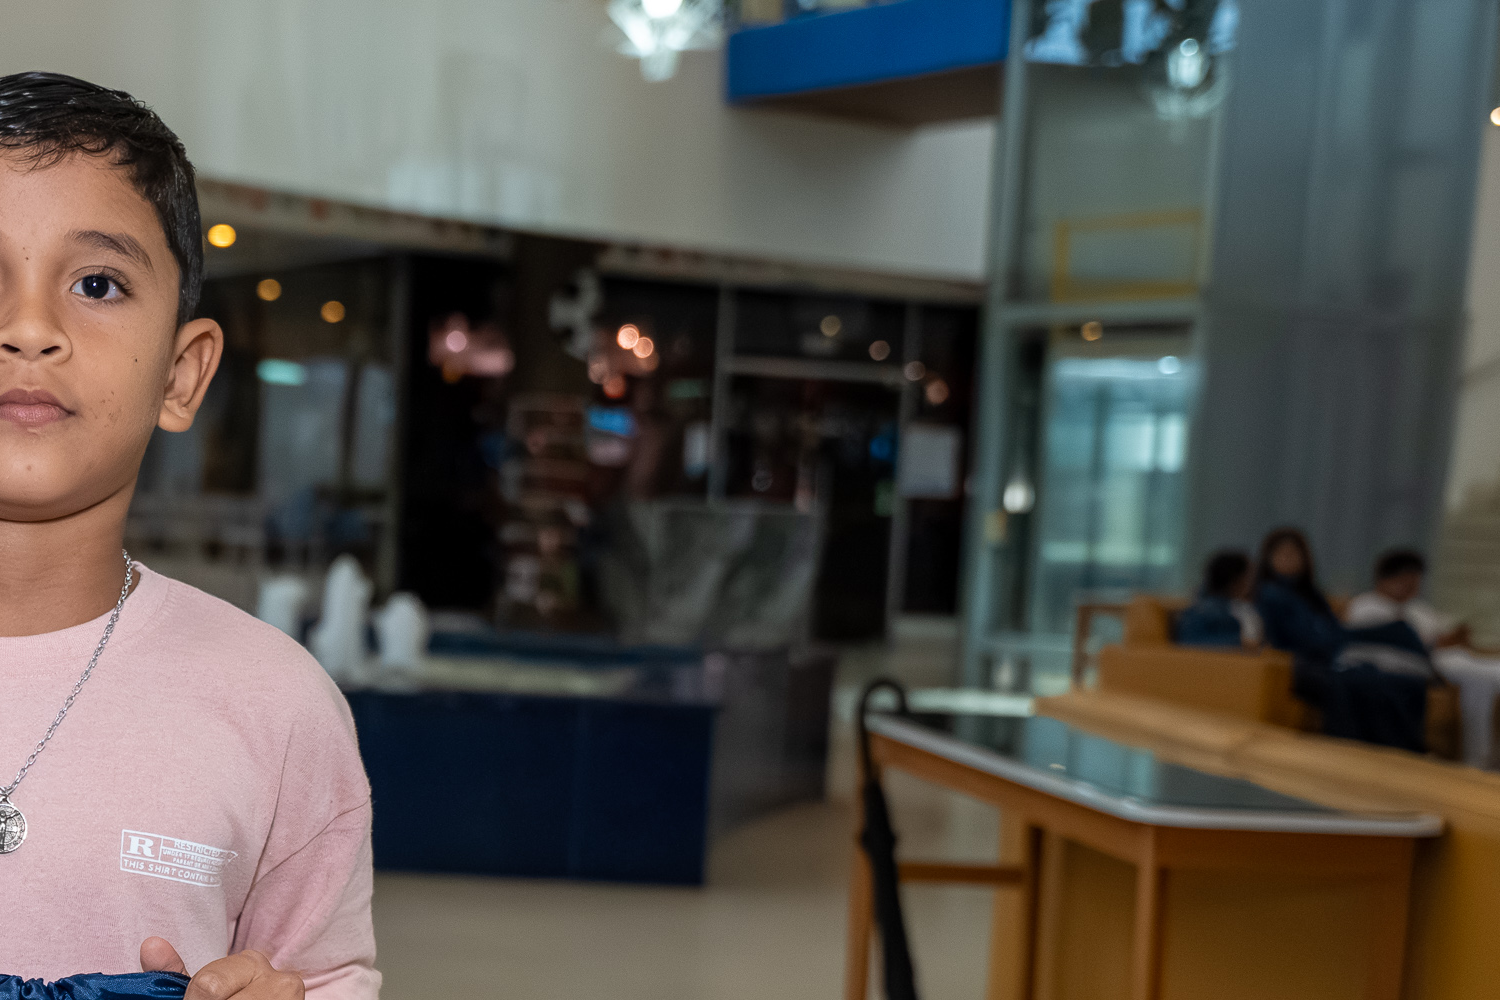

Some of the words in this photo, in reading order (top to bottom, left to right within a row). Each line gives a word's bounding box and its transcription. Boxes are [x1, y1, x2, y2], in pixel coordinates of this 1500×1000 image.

[126, 835, 155, 858] R
[174, 840, 220, 857] RESTRICTED
[123, 859, 145, 871] THIS
[148, 863, 176, 876] SHIRT
